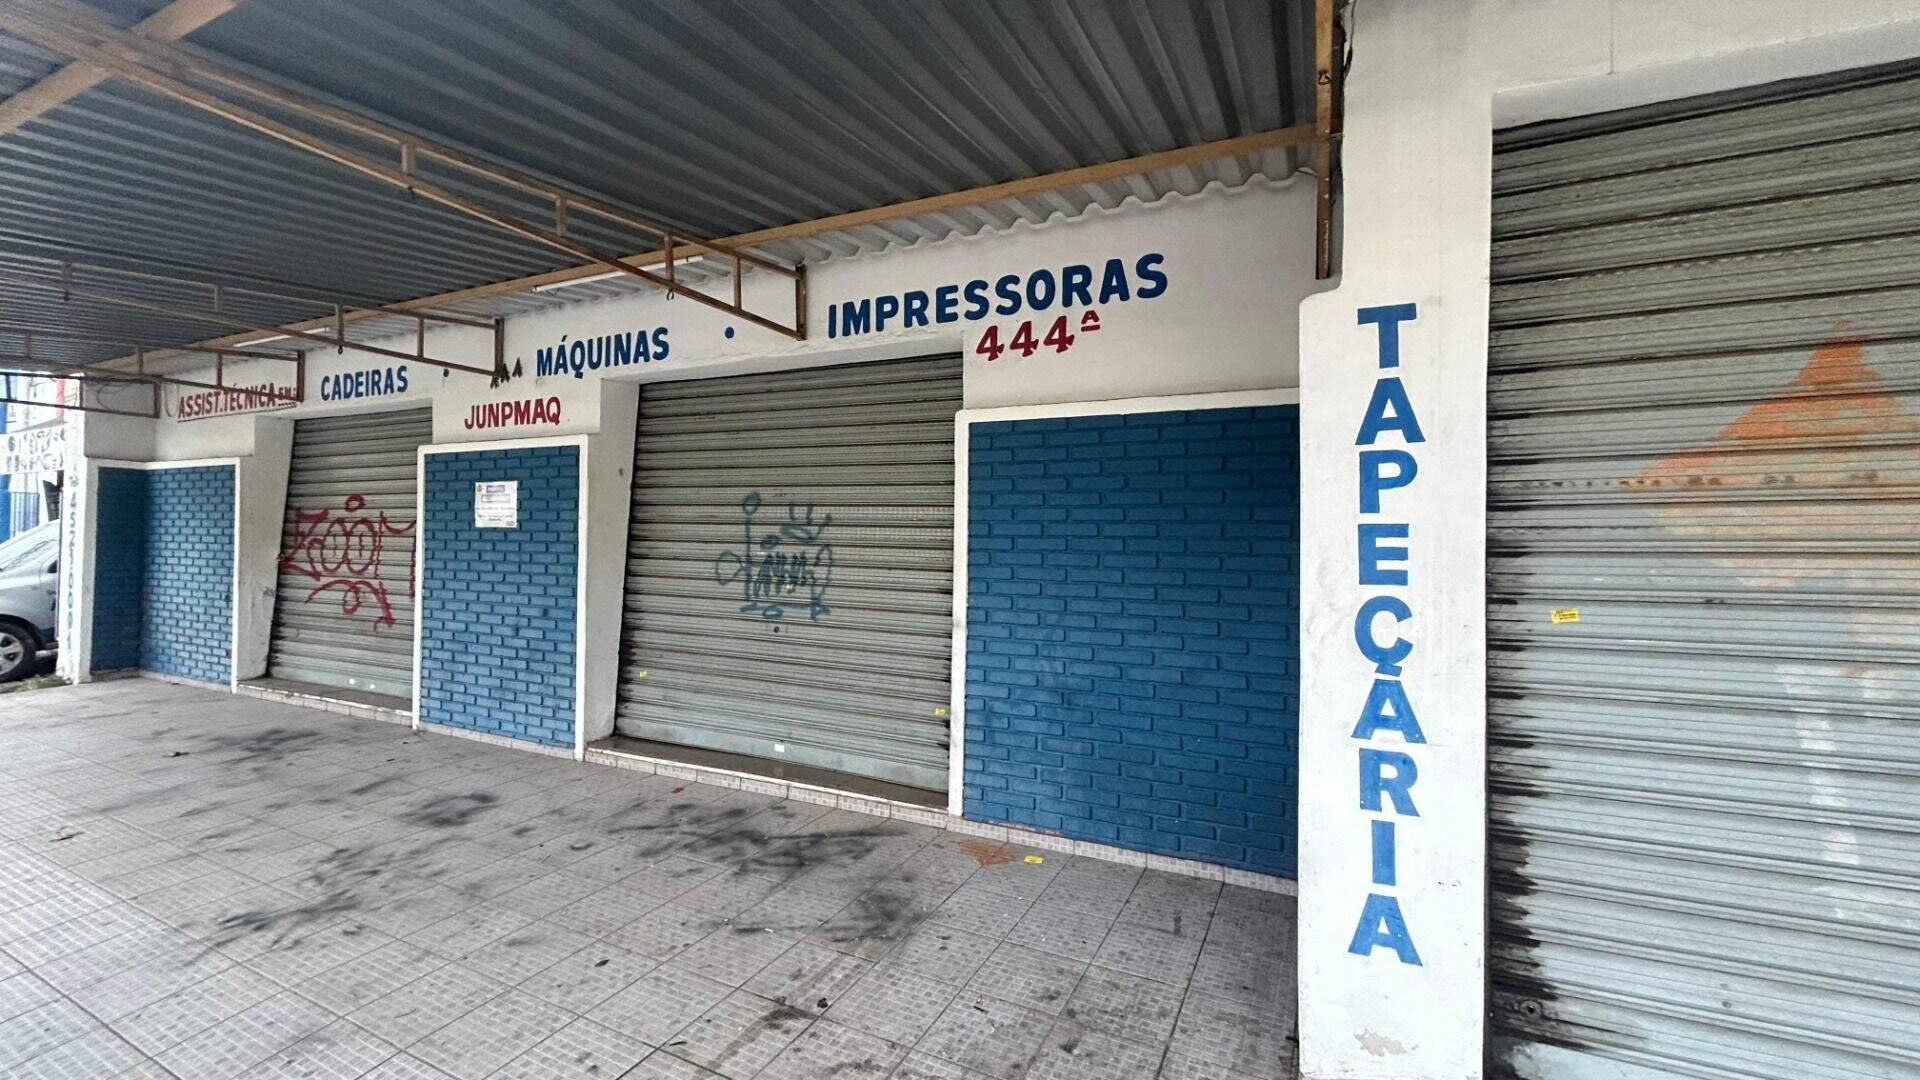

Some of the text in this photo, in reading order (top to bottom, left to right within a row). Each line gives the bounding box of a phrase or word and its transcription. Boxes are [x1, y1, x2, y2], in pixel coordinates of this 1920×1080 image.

[828, 252, 1168, 339] IMPRESSORAS
[536, 326, 671, 379] MÁQUINAS
[320, 364, 408, 401] CADEIRAS
[464, 396, 561, 429] JUNPMAQ
[1348, 302, 1427, 967] TAPEÇARIA
